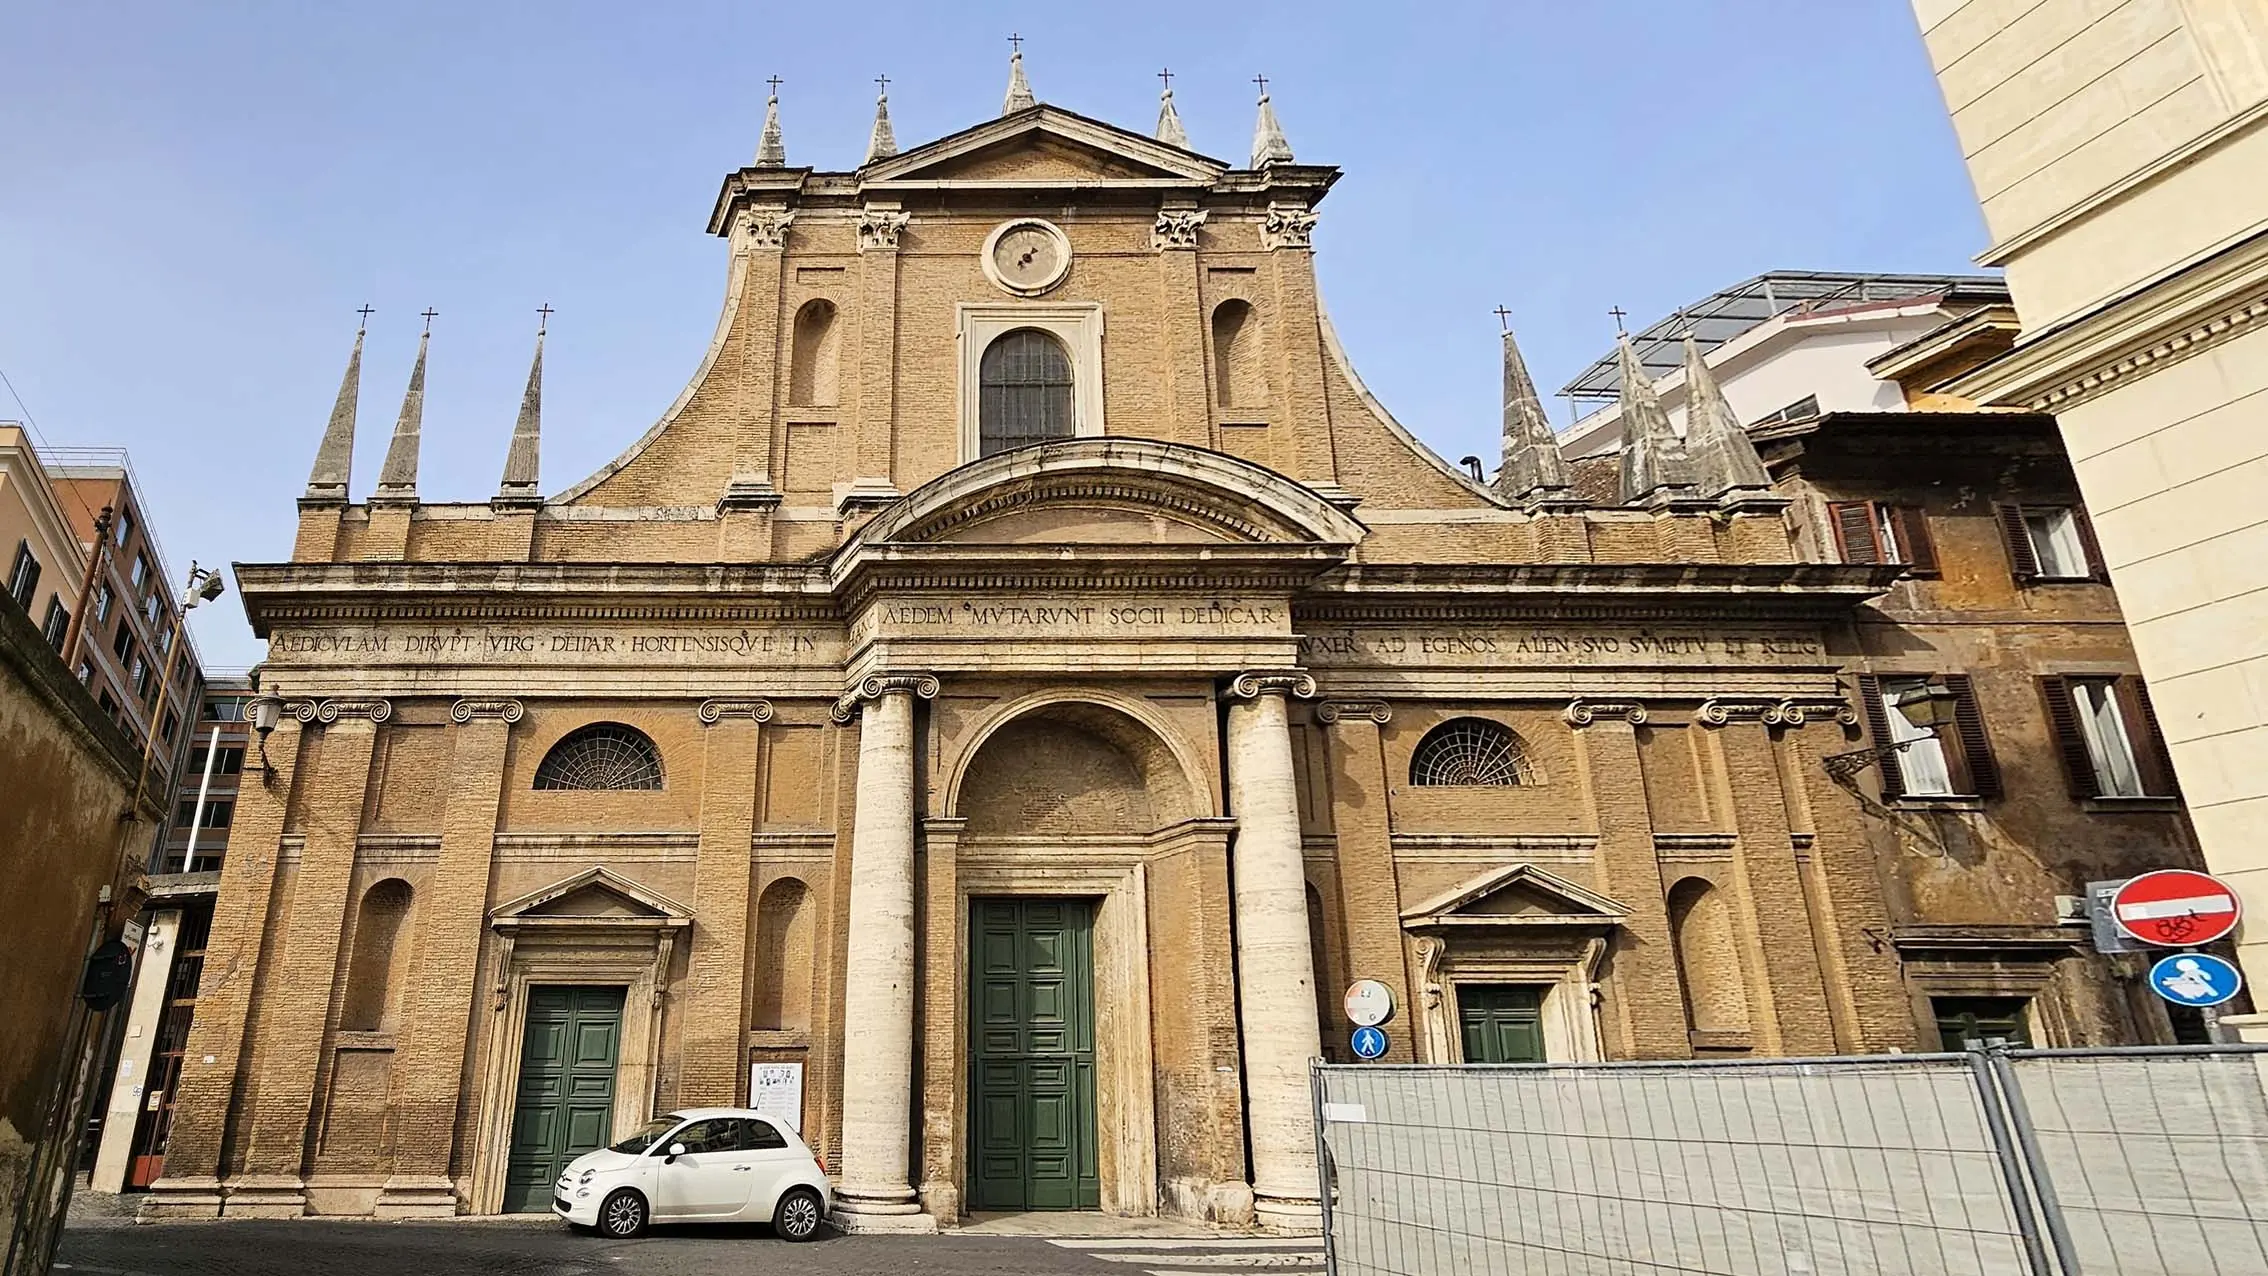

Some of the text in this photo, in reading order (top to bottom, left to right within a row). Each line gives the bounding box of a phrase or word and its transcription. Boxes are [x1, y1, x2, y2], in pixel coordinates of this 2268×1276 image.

[882, 606, 953, 625] AEDEM
[971, 607, 1095, 625] MVTARVNT
[1110, 606, 1165, 625] SOCII
[1181, 606, 1278, 625] DEDICAR
[270, 634, 815, 656] AEDICVLAM DIRVPT VIRG DEIPAR HORTENSISQVE IN
[1374, 636, 1408, 653] AD
[1421, 636, 1498, 654] EGENOS
[1515, 636, 1570, 654] ALEN
[1582, 637, 1620, 654] SVO
[1629, 637, 1708, 655] SVMPTV
[1723, 637, 1746, 654] ET
